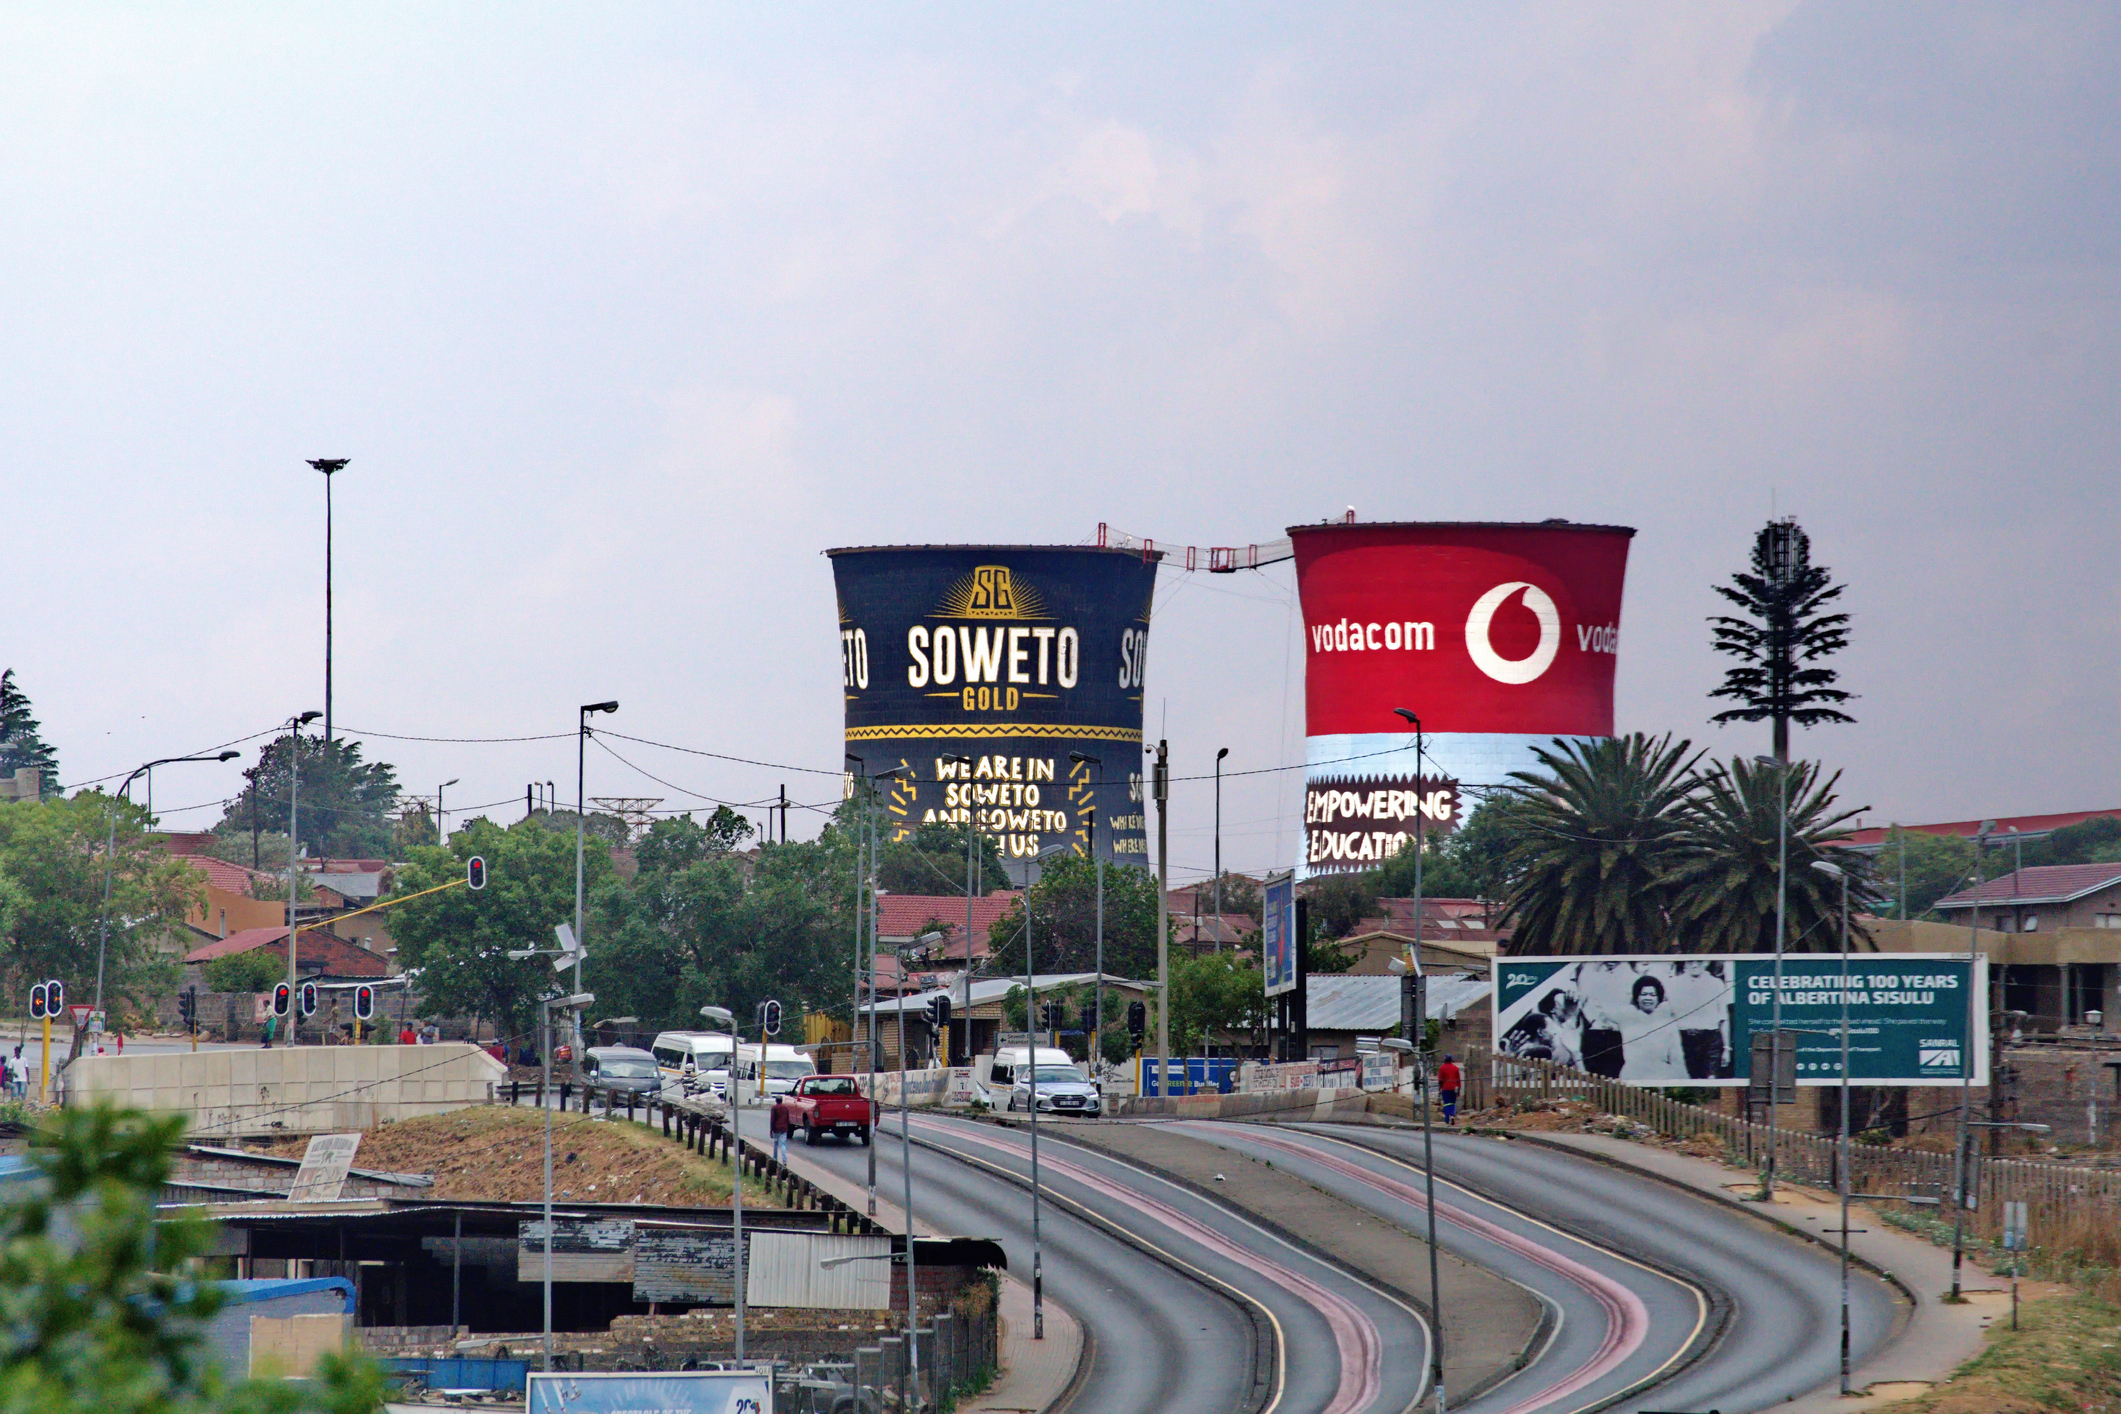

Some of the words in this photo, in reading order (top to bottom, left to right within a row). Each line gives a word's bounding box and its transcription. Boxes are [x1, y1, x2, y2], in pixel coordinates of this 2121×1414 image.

[1312, 618, 1435, 653] vodacom
[908, 625, 1079, 689] SOWETO
[963, 686, 1019, 711] GOLD
[935, 756, 971, 782] WE
[973, 755, 1023, 781] ARE
[1026, 757, 1055, 782] IN
[945, 783, 1040, 807] SOWETO
[1307, 790, 1452, 823] EMPOWERING
[976, 808, 1067, 833] SOWETO
[1009, 834, 1039, 858] US
[1867, 975, 1899, 988] 100
[1901, 975, 1959, 989] YEARS
[1748, 991, 1772, 1005] OF
[1872, 991, 1935, 1005] SISULU
